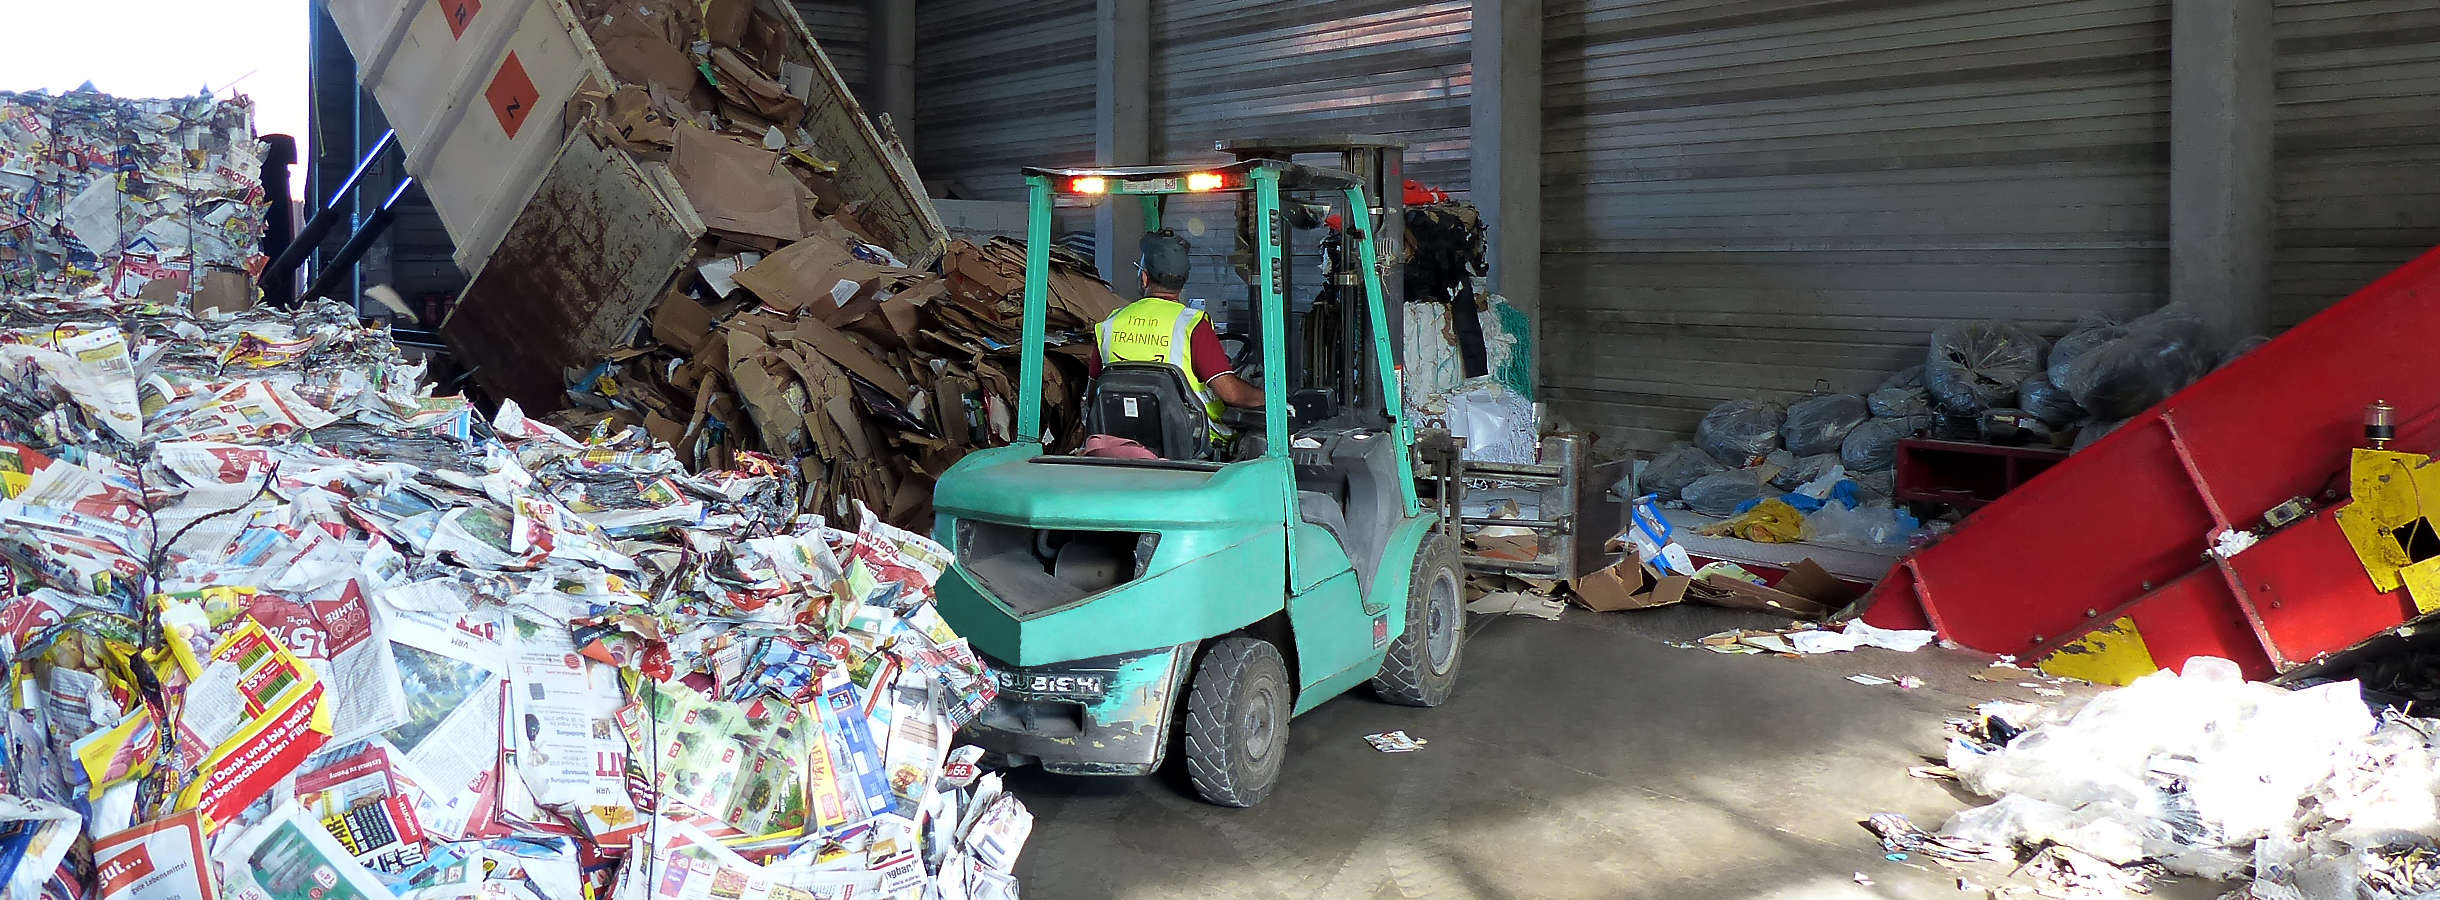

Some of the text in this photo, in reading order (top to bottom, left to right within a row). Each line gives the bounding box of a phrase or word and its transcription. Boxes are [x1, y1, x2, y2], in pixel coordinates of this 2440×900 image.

[1128, 315, 1158, 327] I'm in
[1113, 331, 1169, 347] TRAINING
[325, 596, 359, 624] JAHRE
[244, 673, 267, 690] 15%
[214, 757, 247, 783] Dank
[246, 739, 269, 760] und
[267, 725, 286, 744] bis
[284, 706, 312, 728] bald
[213, 739, 290, 798] benachbarten
